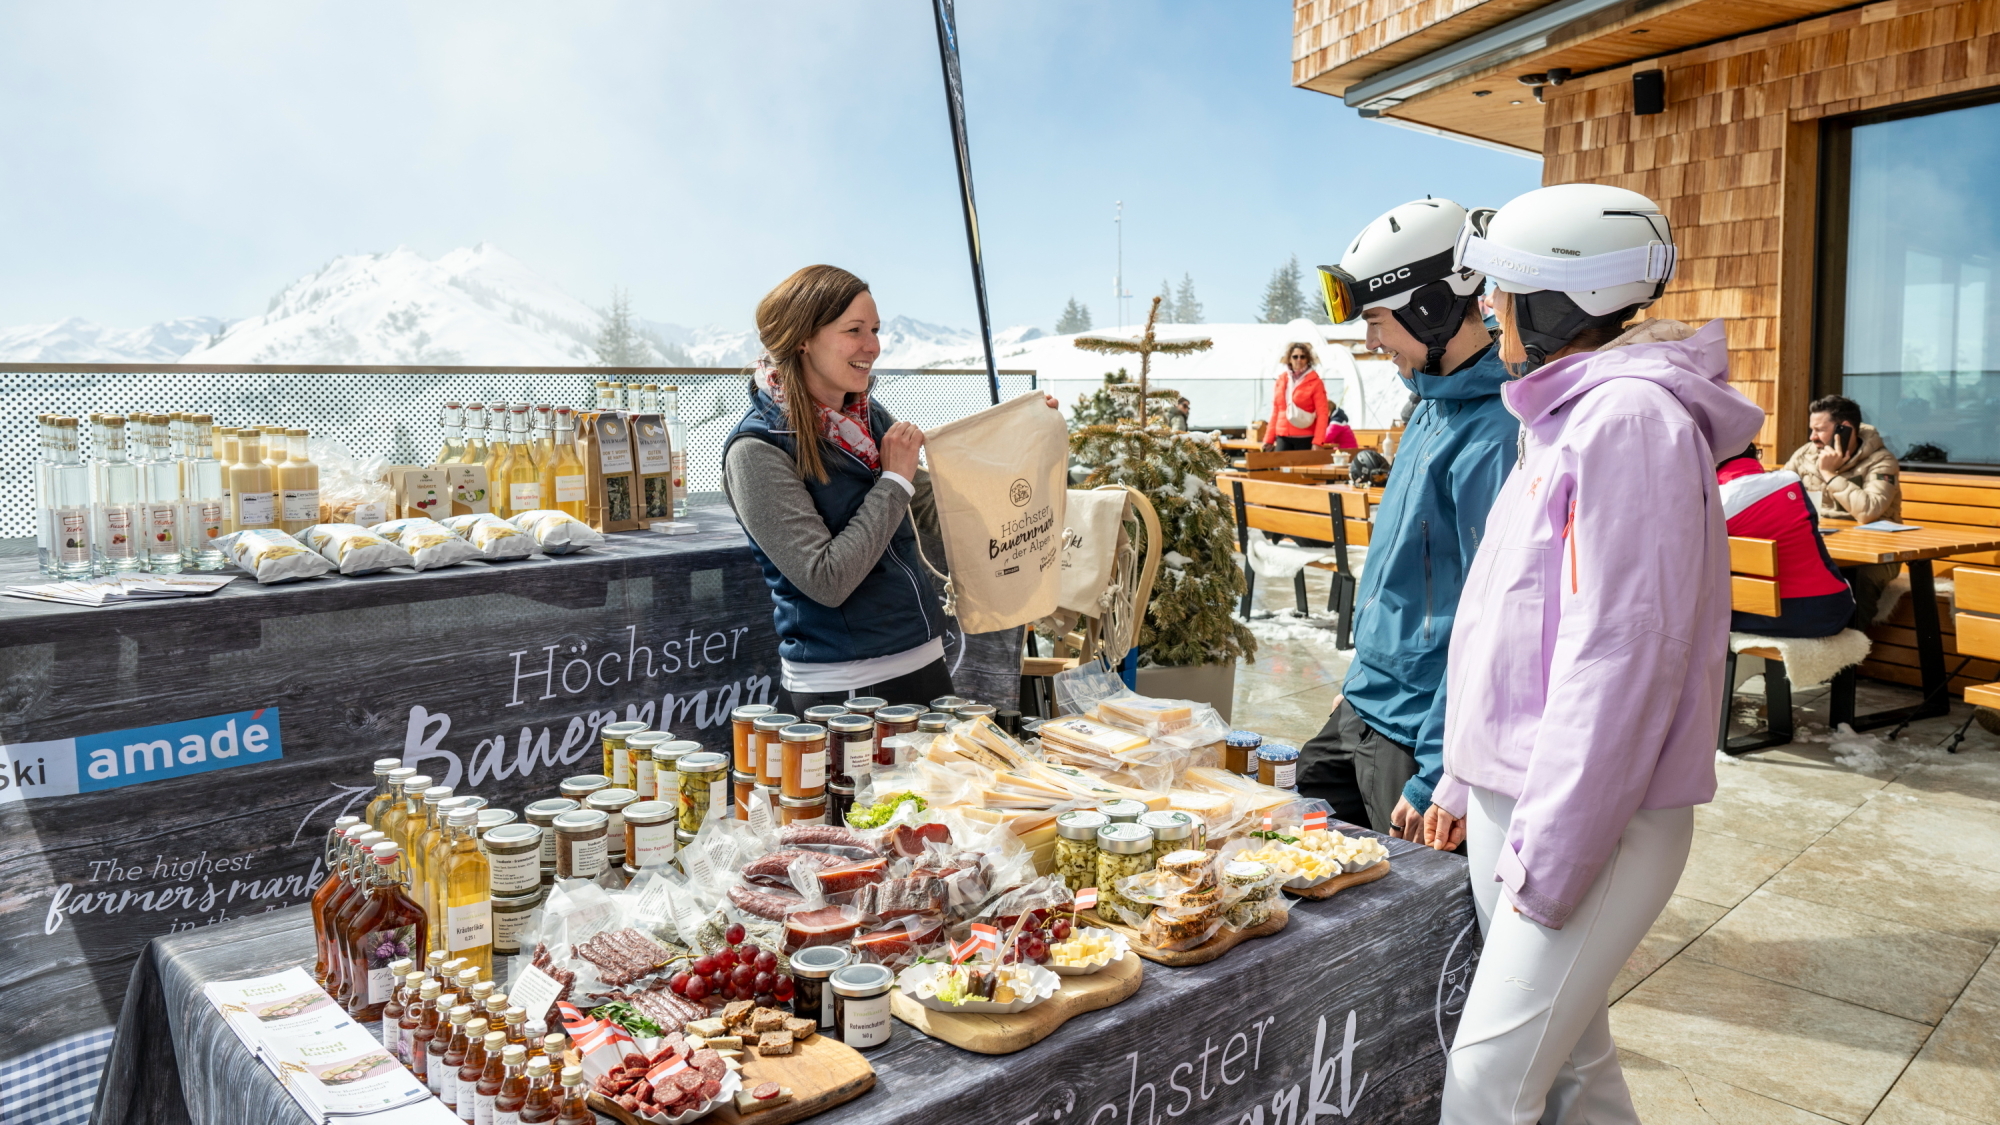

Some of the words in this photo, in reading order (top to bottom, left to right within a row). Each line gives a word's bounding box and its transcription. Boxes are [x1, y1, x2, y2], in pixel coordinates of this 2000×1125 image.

[1489, 255, 1540, 276] ATOMIC
[1551, 247, 1581, 257] ATOMIC
[1001, 506, 1050, 538] Höchster
[1012, 547, 1028, 560] der
[505, 624, 749, 708] Höchster
[87, 708, 271, 781] amadé
[402, 674, 780, 793] Bauernmar
[89, 859, 143, 884] The
[152, 850, 255, 887] highest
[45, 874, 216, 935] farmer's
[228, 857, 323, 905] mark
[456, 923, 485, 935] Kräuterlikör
[849, 1020, 885, 1030] Rotweinchutney
